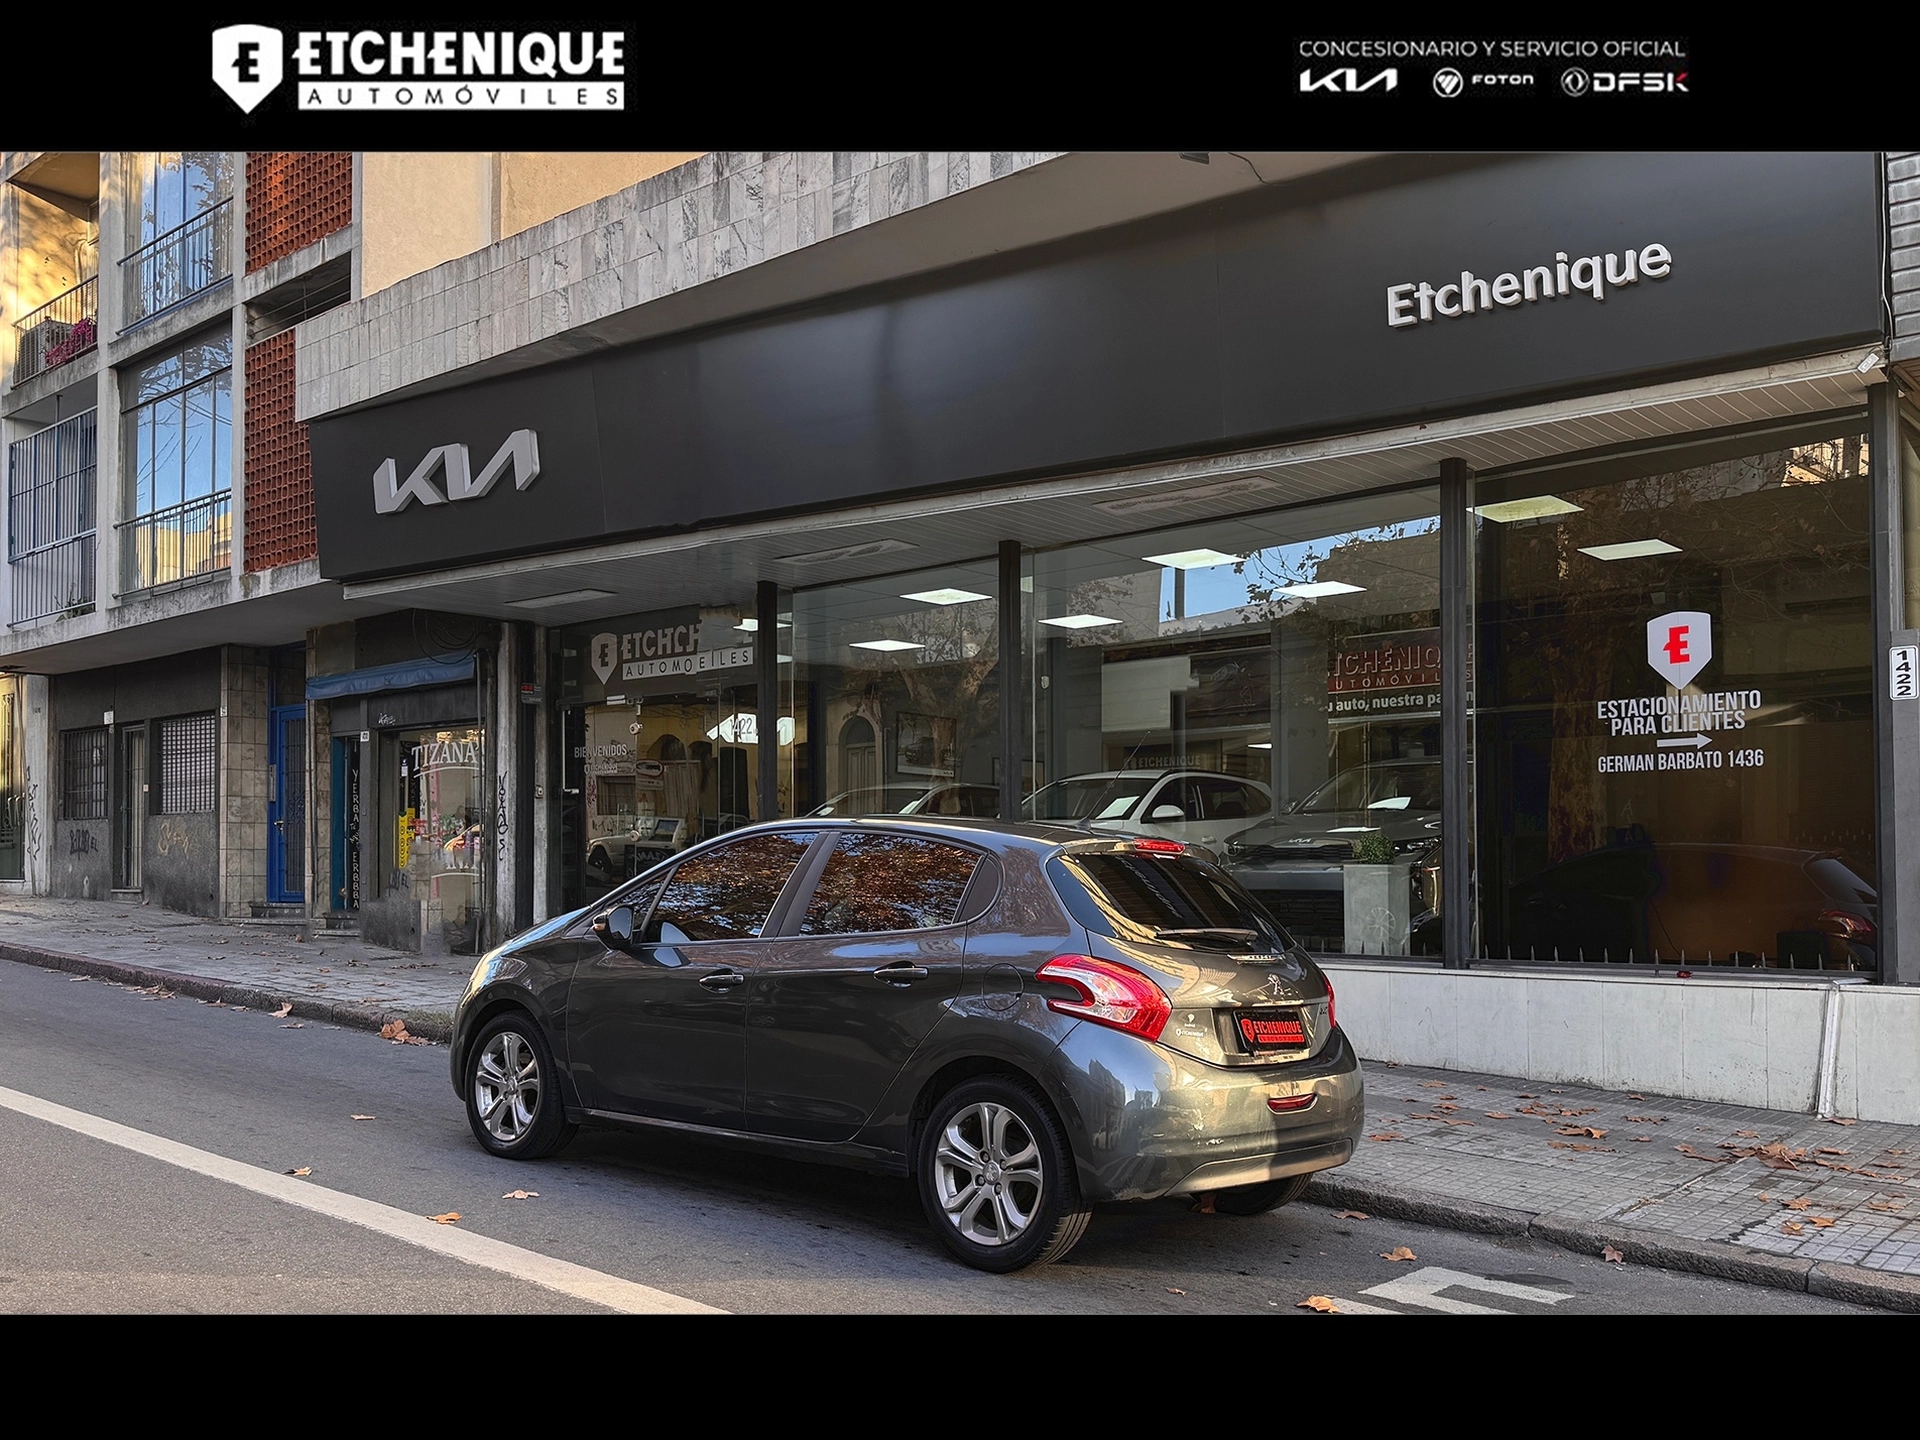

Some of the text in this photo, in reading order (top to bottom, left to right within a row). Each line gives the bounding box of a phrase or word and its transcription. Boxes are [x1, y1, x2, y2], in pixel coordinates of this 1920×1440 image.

[1387, 243, 1672, 328] Etchenique
[1896, 650, 1911, 696] 1422
[1373, 694, 1424, 709] nuestra
[1598, 690, 1761, 719] ESTACIONAMIENTO
[1611, 710, 1746, 736] PARA CLIENTES
[1598, 749, 1764, 773] GERMAN BARBATO 1436
